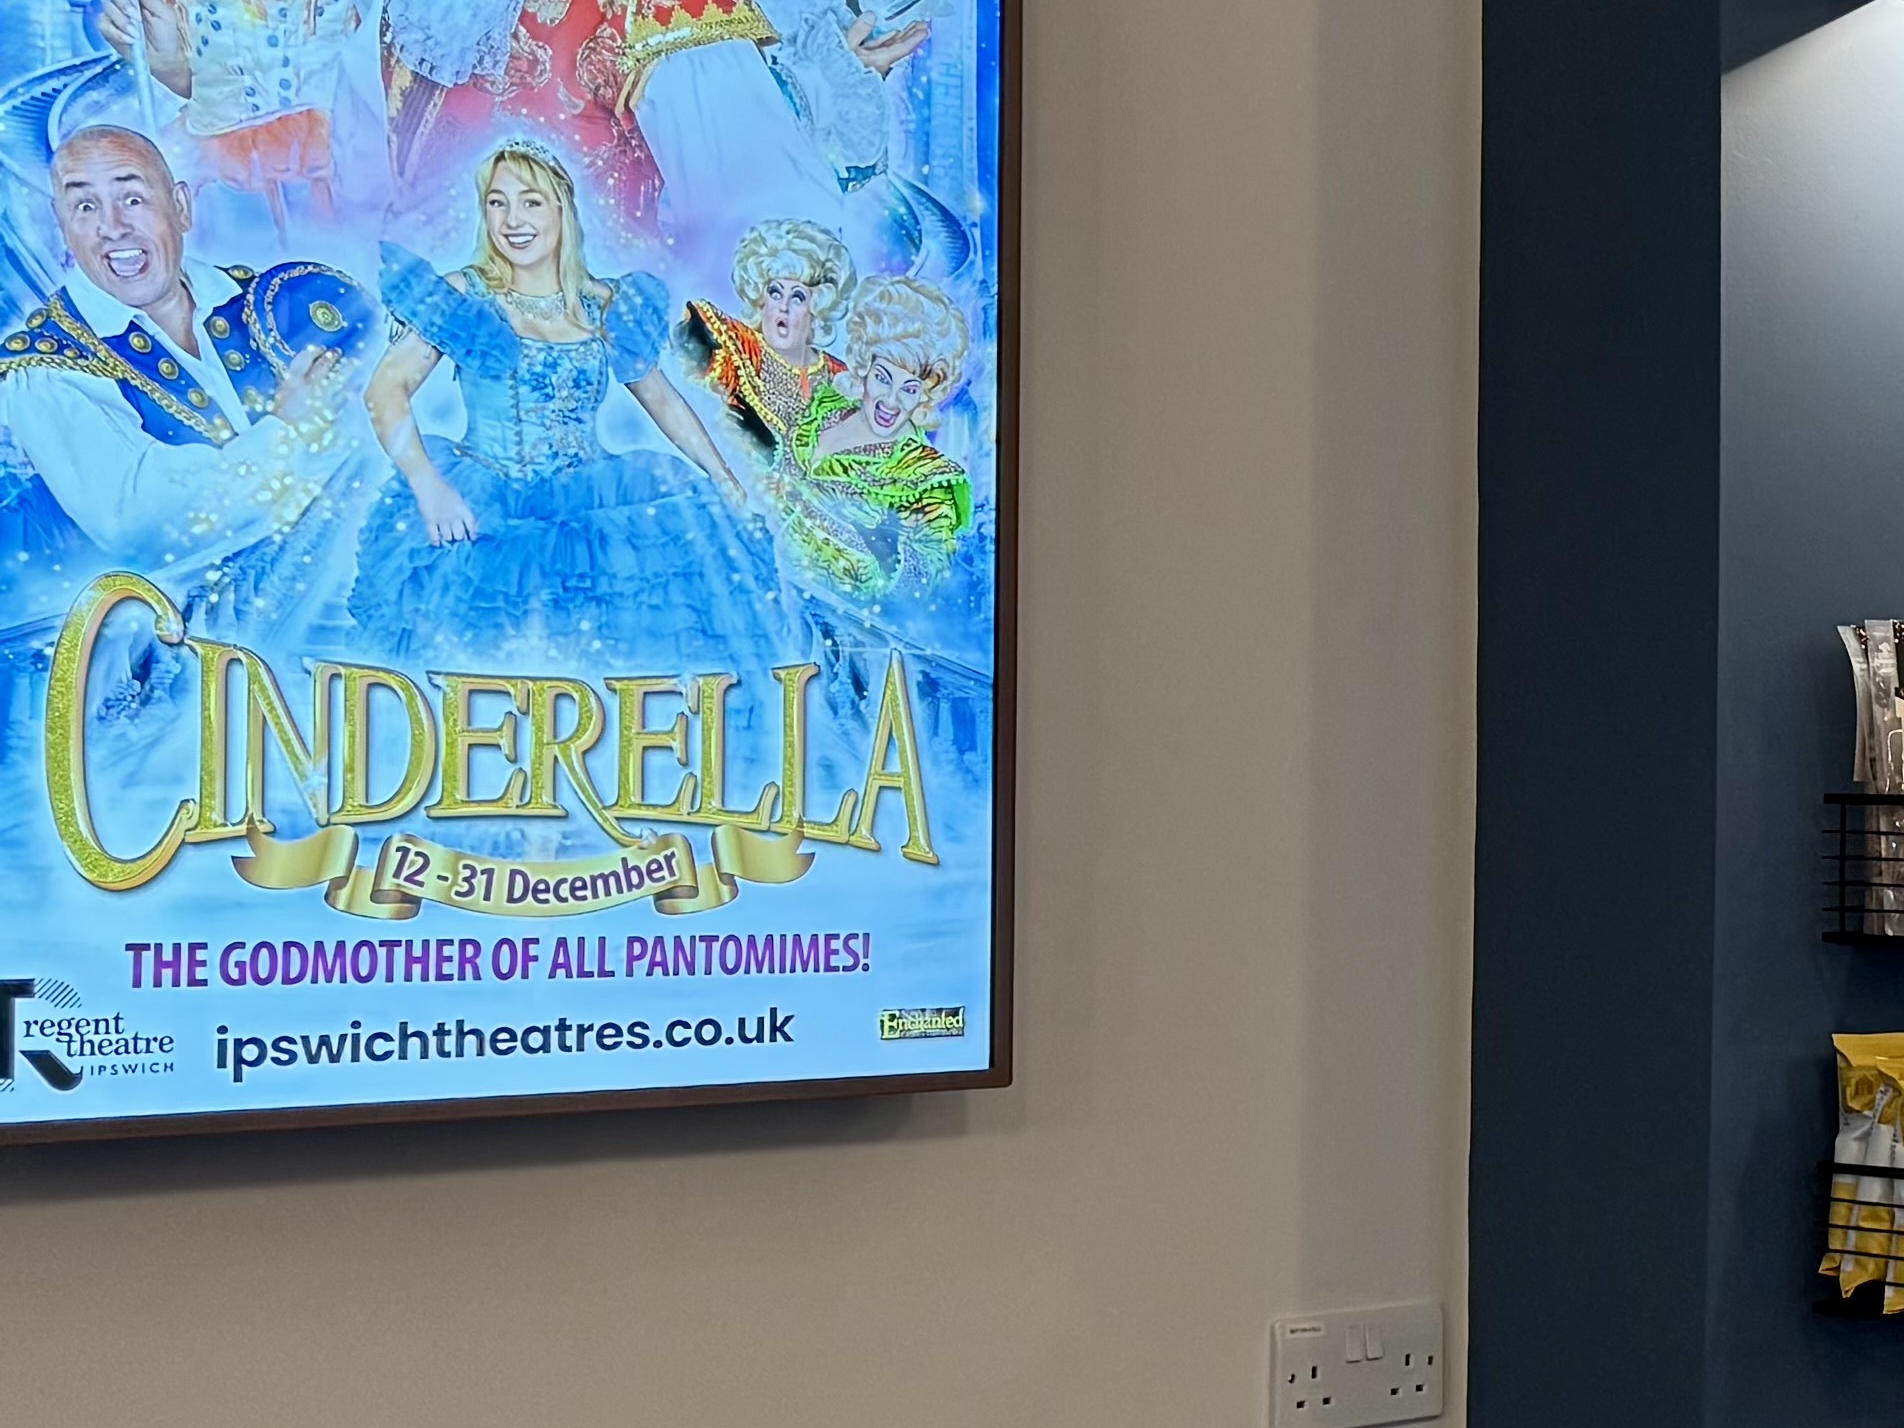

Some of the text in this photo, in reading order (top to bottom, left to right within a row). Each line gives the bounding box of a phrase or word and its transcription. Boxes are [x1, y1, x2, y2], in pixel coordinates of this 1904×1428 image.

[44, 570, 941, 893] CINDERELLA
[391, 843, 429, 889] 12
[453, 860, 494, 902] 31
[504, 844, 683, 907] December
[125, 930, 870, 990] THE GODMOTHER OF ALL PANTOMIMES!
[23, 1012, 125, 1044] regent
[66, 1032, 174, 1058] theatre
[215, 1006, 795, 1085] ipswichtheatres.co.uk
[881, 1007, 964, 1039] Enchanted
[90, 1061, 174, 1076] IPSWICH
